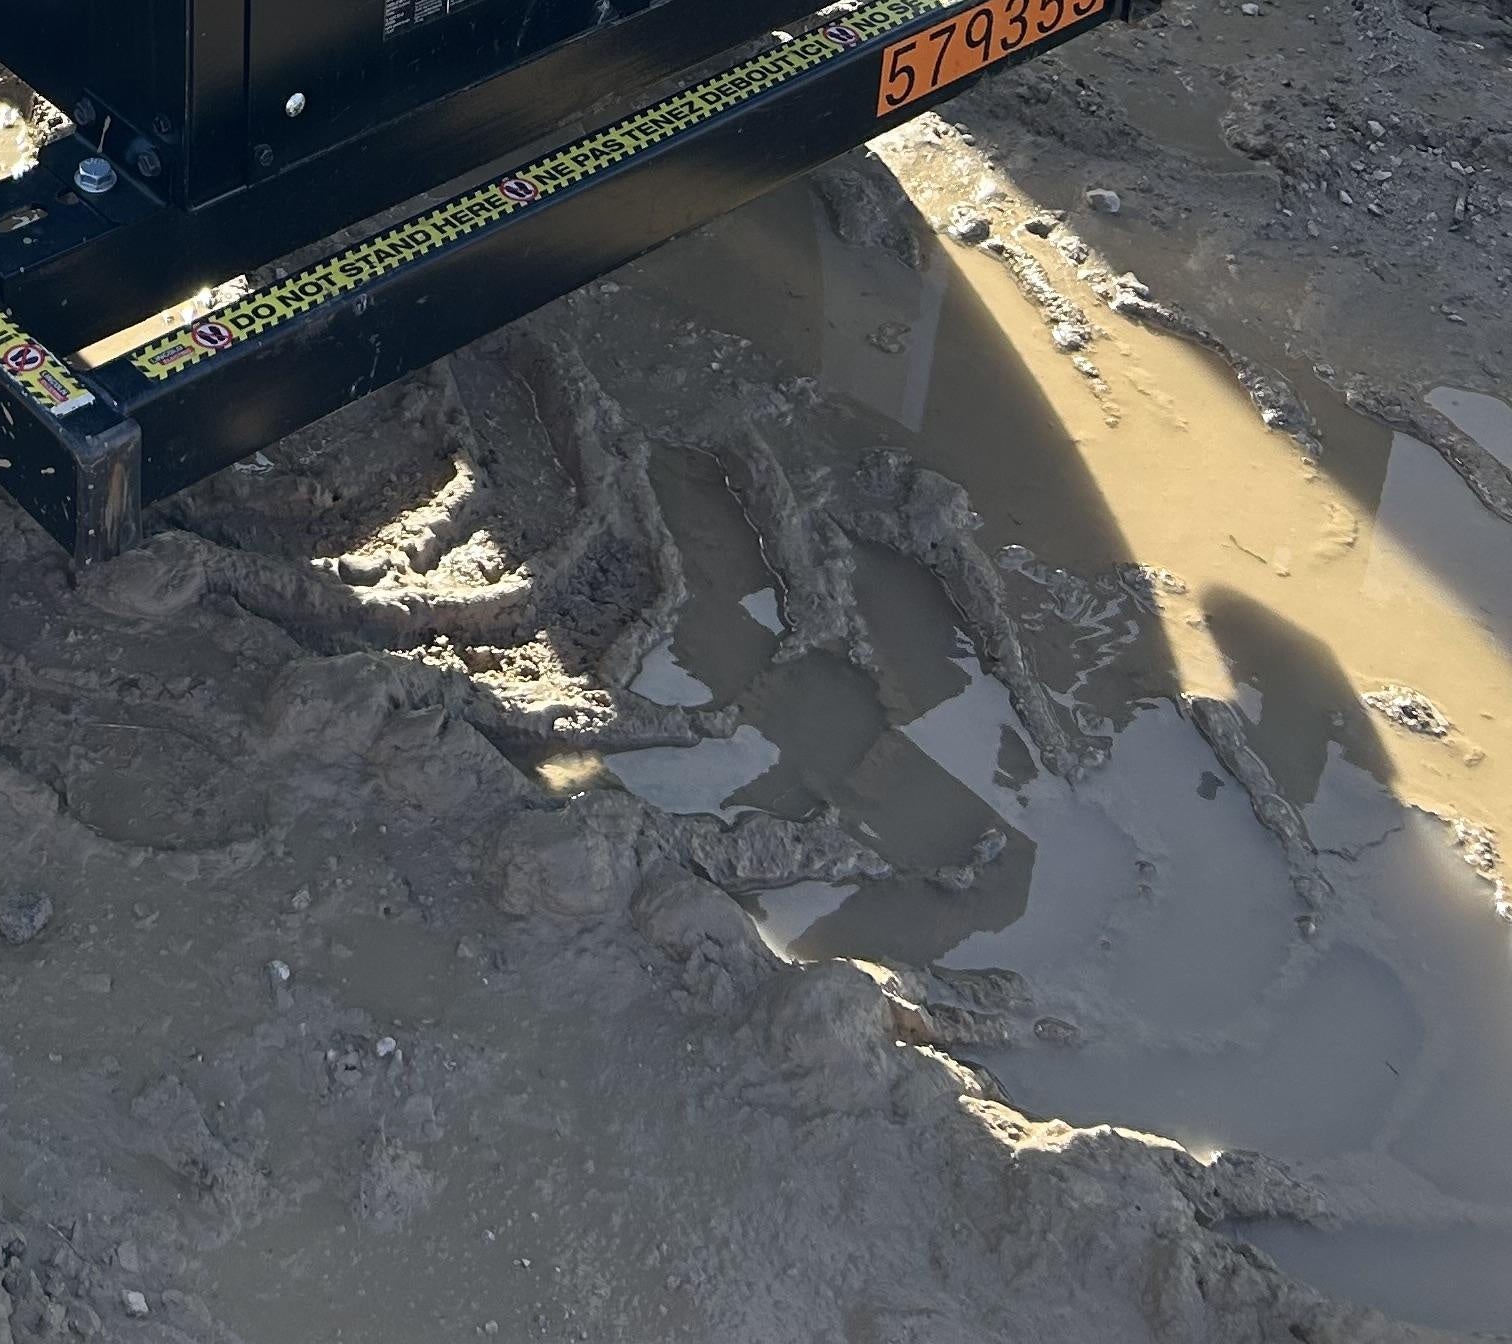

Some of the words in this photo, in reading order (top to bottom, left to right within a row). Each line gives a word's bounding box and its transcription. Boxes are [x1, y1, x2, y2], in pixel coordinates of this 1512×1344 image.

[852, 9, 890, 33] NO
[532, 161, 571, 187] NE
[571, 138, 626, 169] PAS
[627, 100, 704, 143] TENEZ
[701, 50, 800, 106] DEBOUT
[796, 34, 830, 61] ICI
[229, 303, 276, 331] DO
[276, 276, 336, 312] NOT
[339, 227, 433, 278] STAND
[431, 193, 503, 235] HERE
